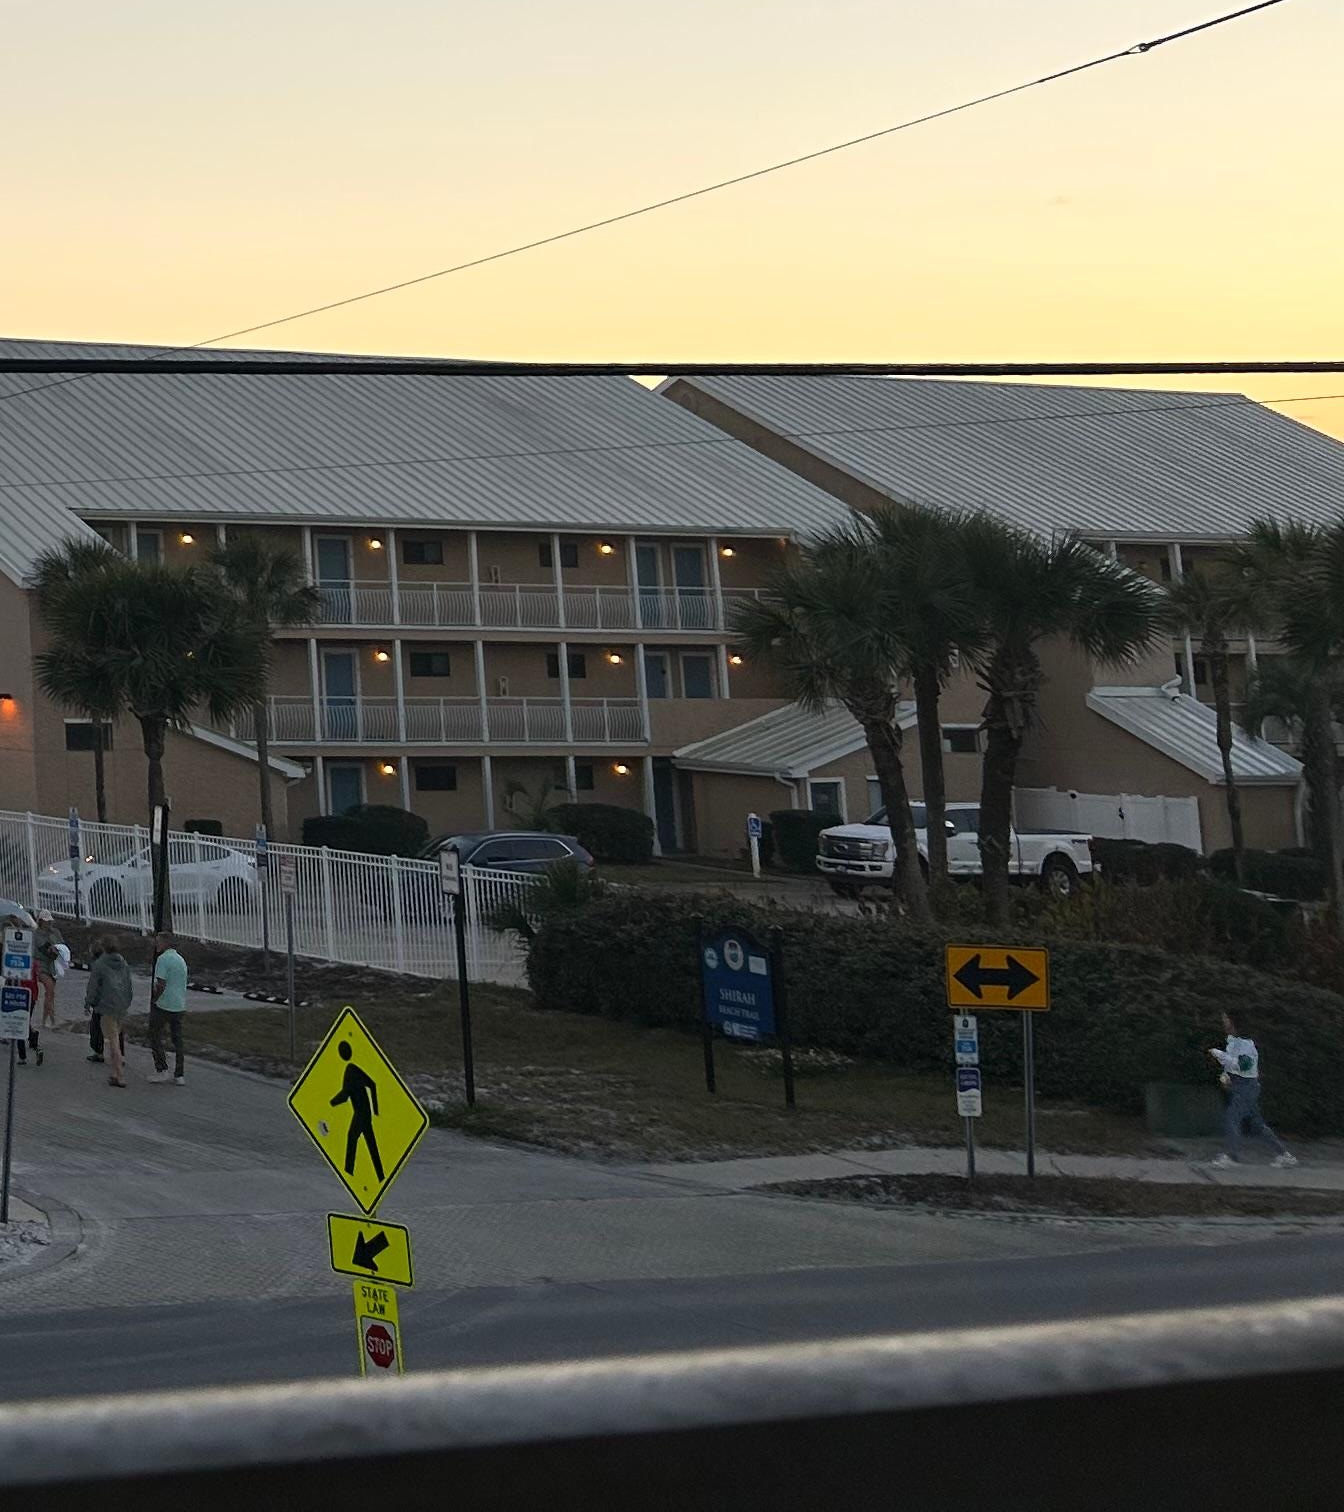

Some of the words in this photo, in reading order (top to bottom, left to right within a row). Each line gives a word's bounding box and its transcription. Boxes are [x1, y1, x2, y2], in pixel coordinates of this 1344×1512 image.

[719, 988, 756, 1005] SHIRAH
[361, 1286, 389, 1302] STATE
[367, 1302, 385, 1315] LAW
[367, 1336, 393, 1357] STOP
